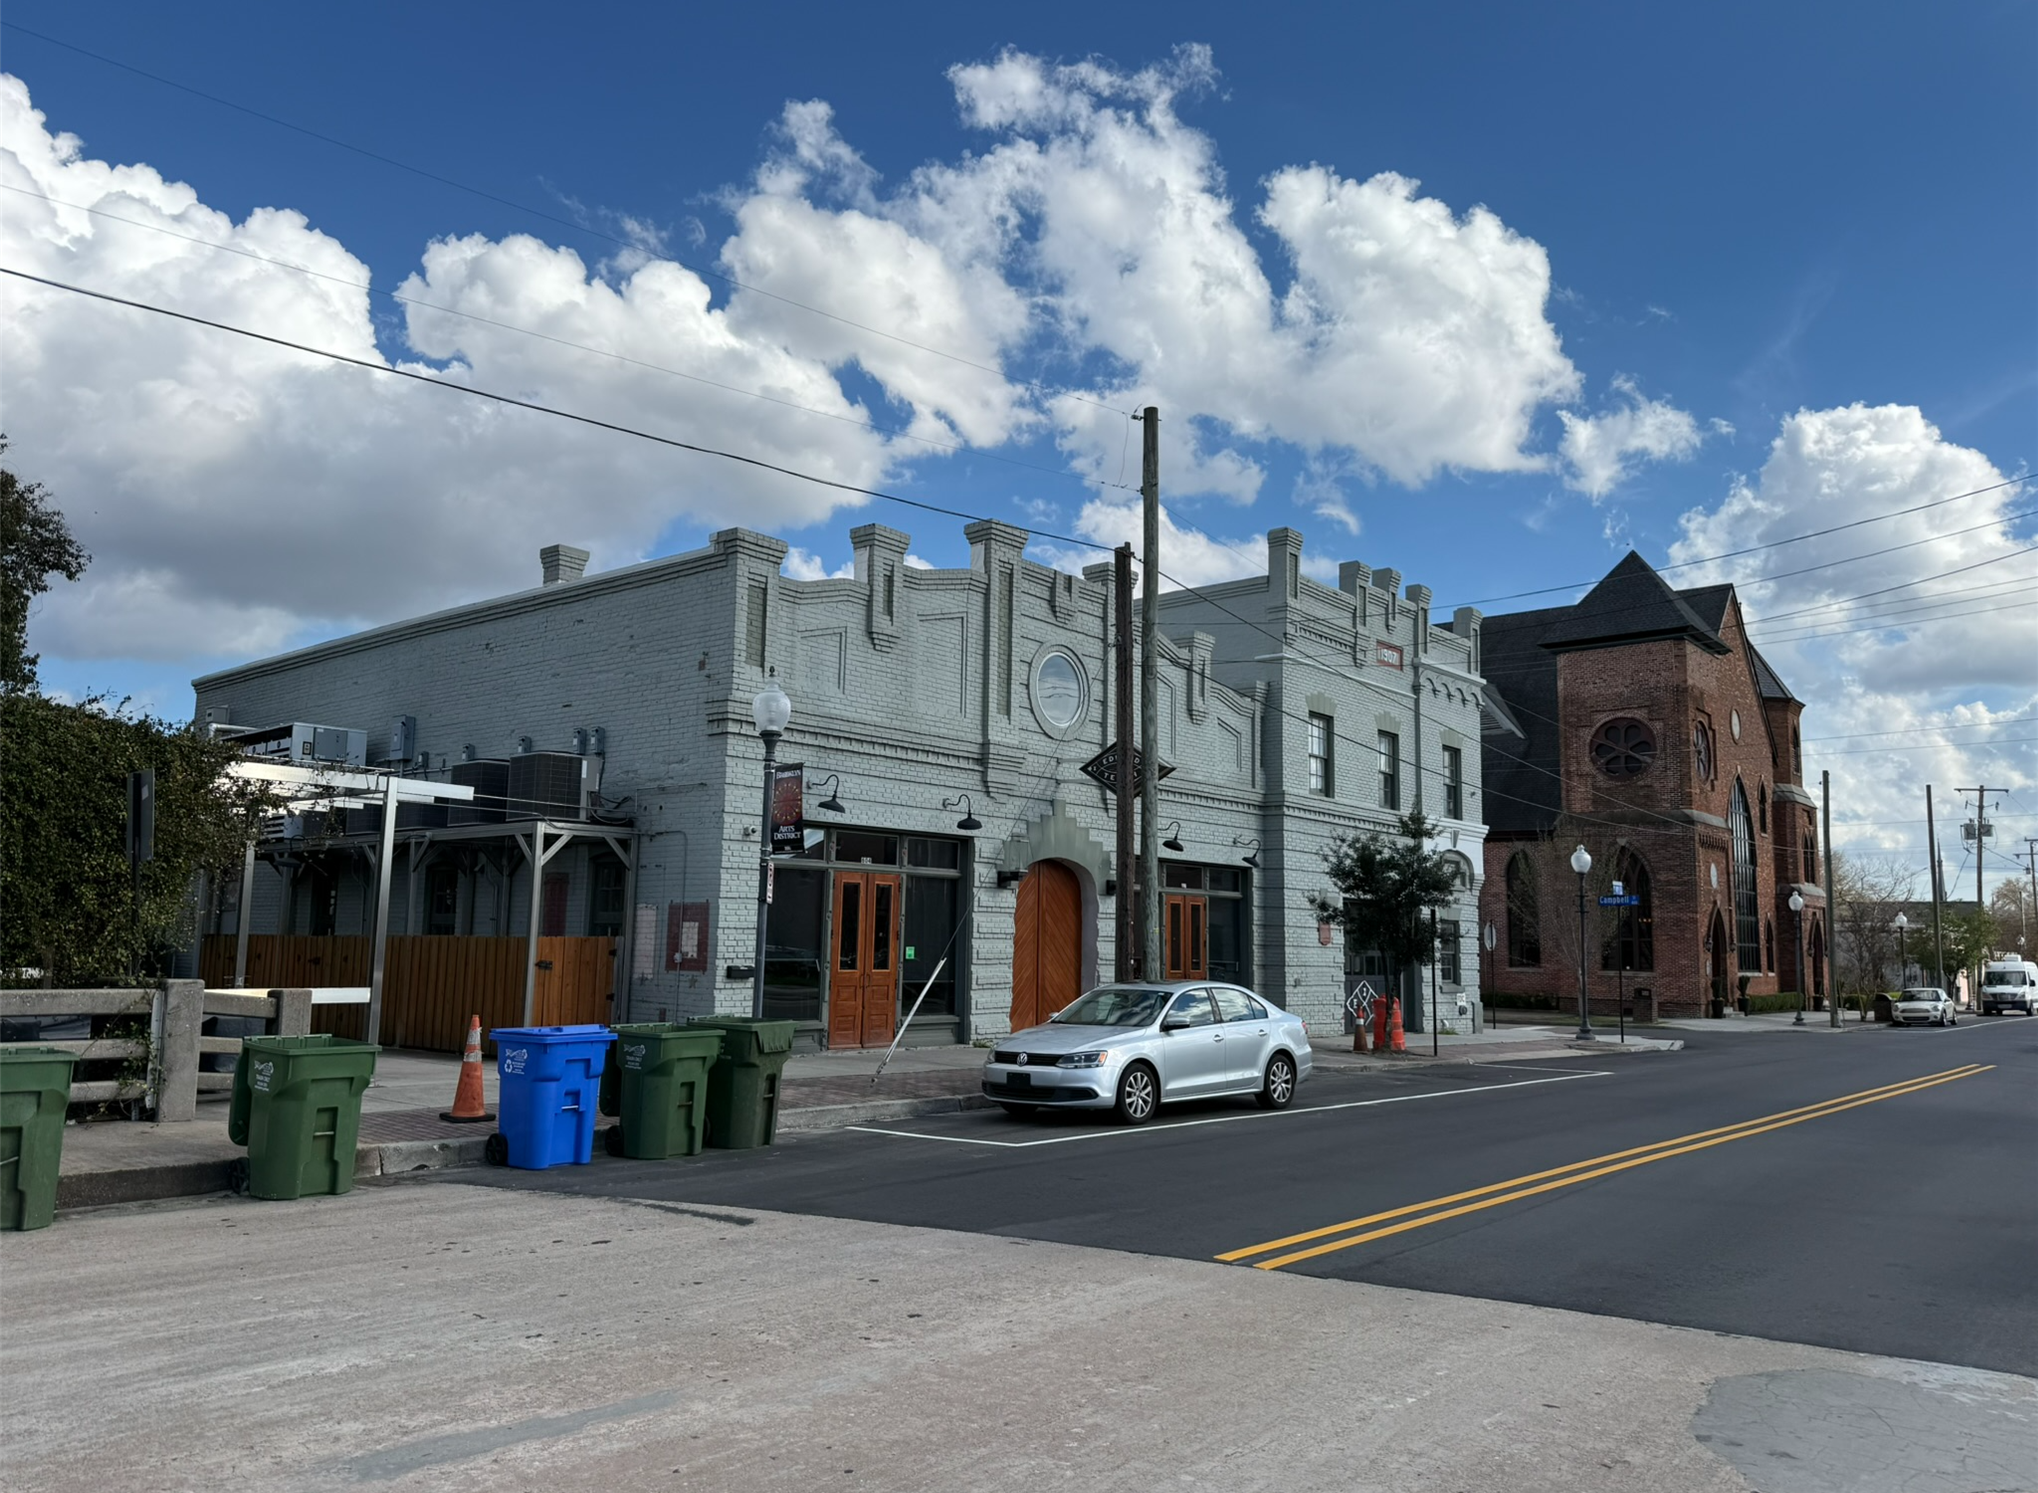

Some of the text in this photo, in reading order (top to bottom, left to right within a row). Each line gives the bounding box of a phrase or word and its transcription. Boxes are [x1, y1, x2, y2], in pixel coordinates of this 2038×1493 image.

[779, 825, 795, 833] ARTS
[774, 832, 801, 840] DISTRICT
[1600, 896, 1629, 904] Campbell
